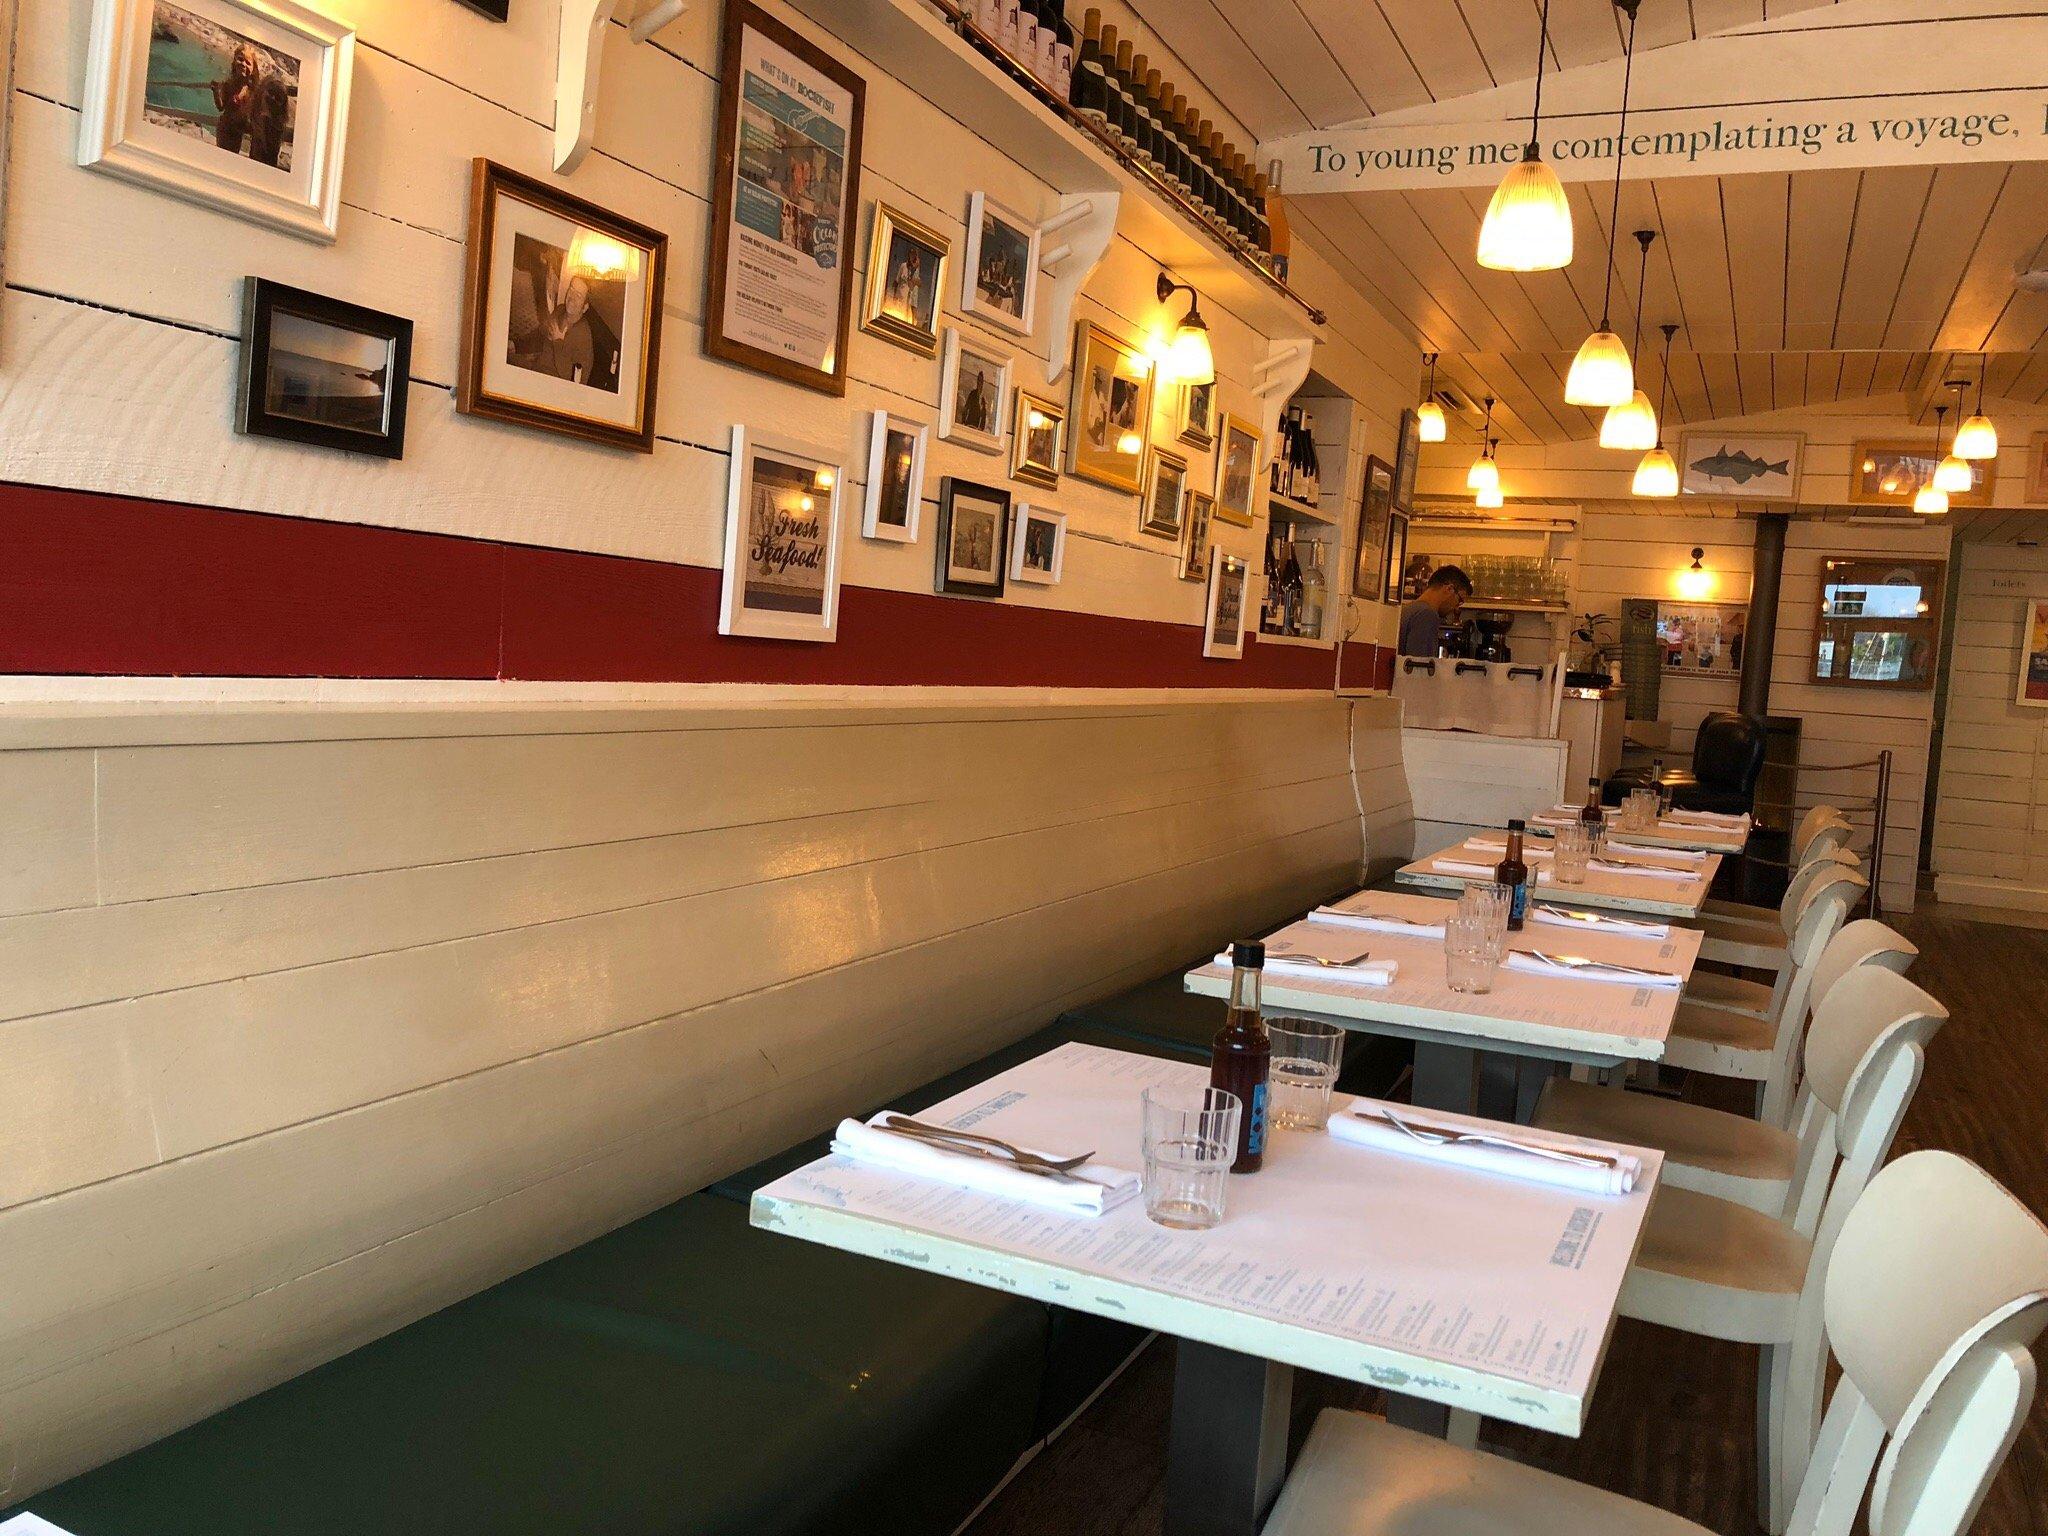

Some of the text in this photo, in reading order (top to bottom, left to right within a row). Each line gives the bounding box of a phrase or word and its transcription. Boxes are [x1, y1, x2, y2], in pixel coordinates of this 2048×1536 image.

[797, 81, 835, 115] ROCKFISH
[1308, 144, 1346, 173] To
[1355, 144, 1459, 178] young
[1552, 117, 1828, 163] contemplating
[1836, 120, 1858, 144] a
[1869, 112, 2020, 149] voyage,
[775, 508, 820, 540] Fresh
[751, 534, 825, 574] Seafood!
